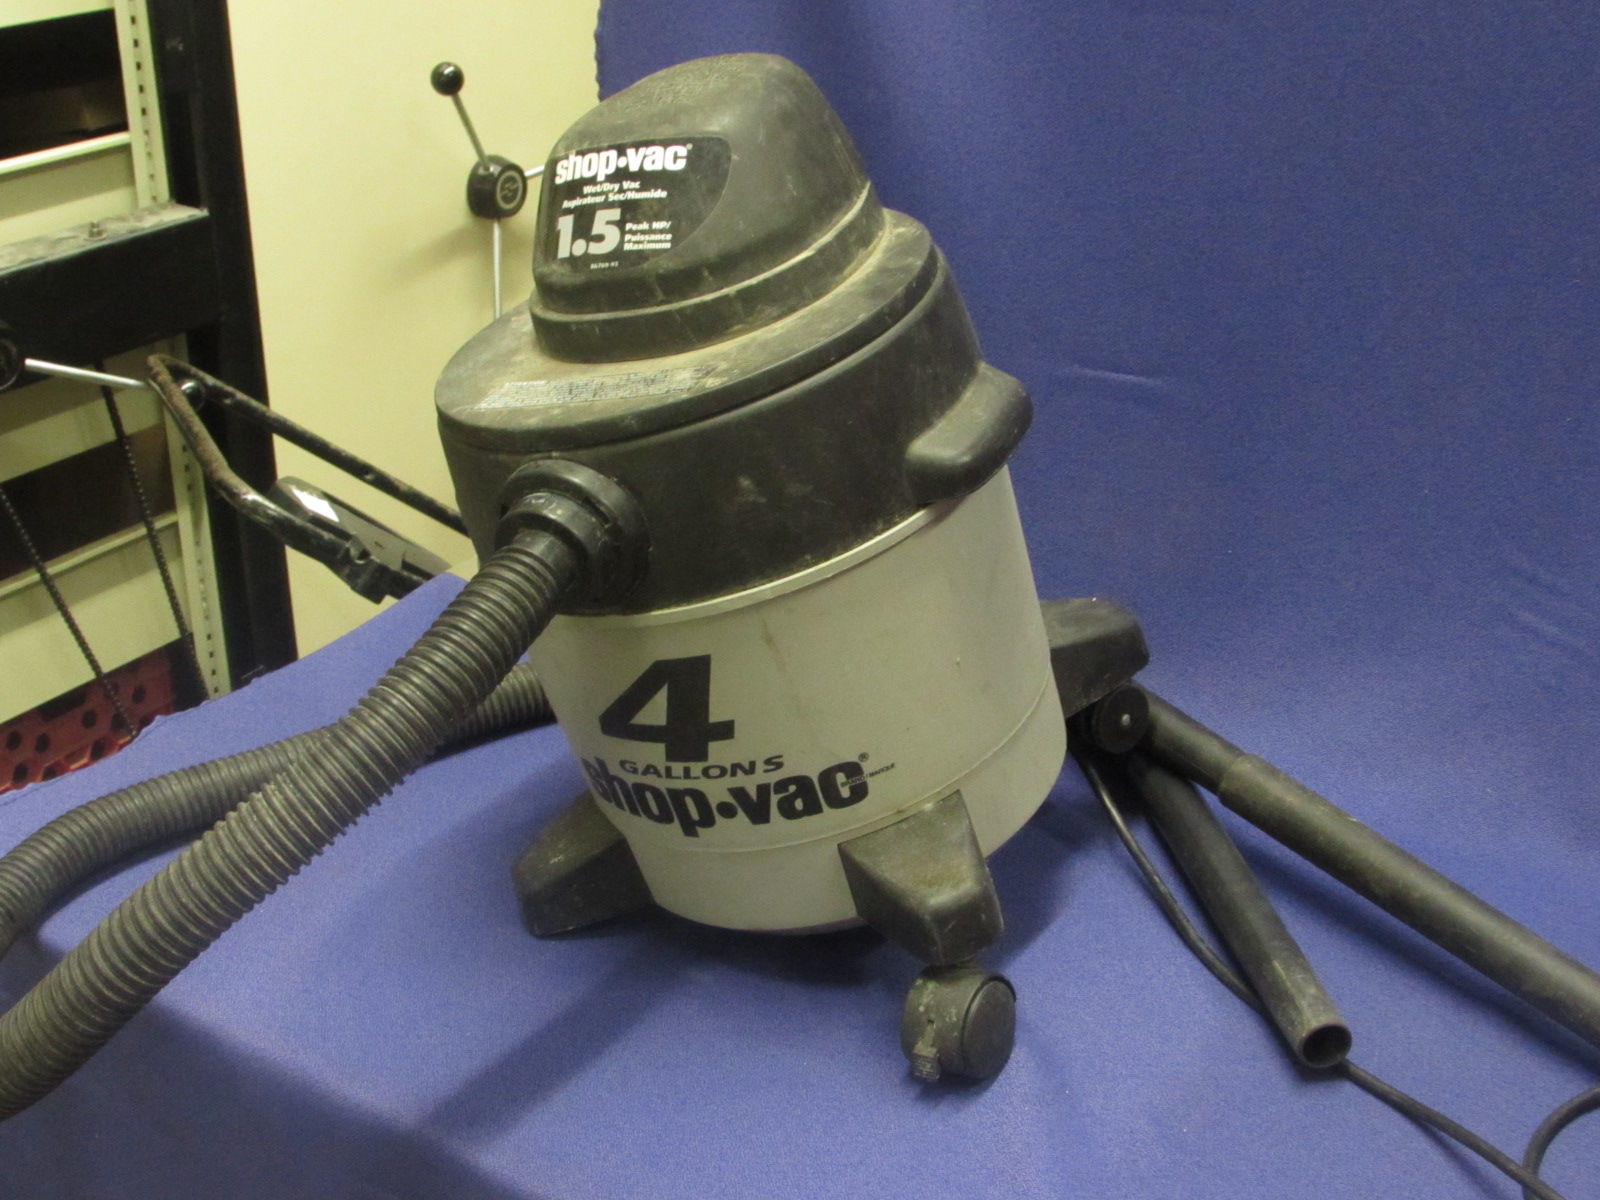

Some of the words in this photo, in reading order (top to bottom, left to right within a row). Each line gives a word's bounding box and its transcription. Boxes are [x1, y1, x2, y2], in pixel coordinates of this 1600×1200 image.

[583, 182, 620, 195] Wet/Dry
[622, 181, 641, 190] Vac
[562, 195, 606, 209] Aspirateur
[608, 189, 668, 202] Sec/Humide
[556, 208, 622, 259] 1.5
[625, 222, 649, 231] Peak
[624, 232, 673, 242] Puissance
[623, 241, 672, 251] Maximum
[599, 654, 735, 762] 4
[618, 754, 785, 780] GALLONS
